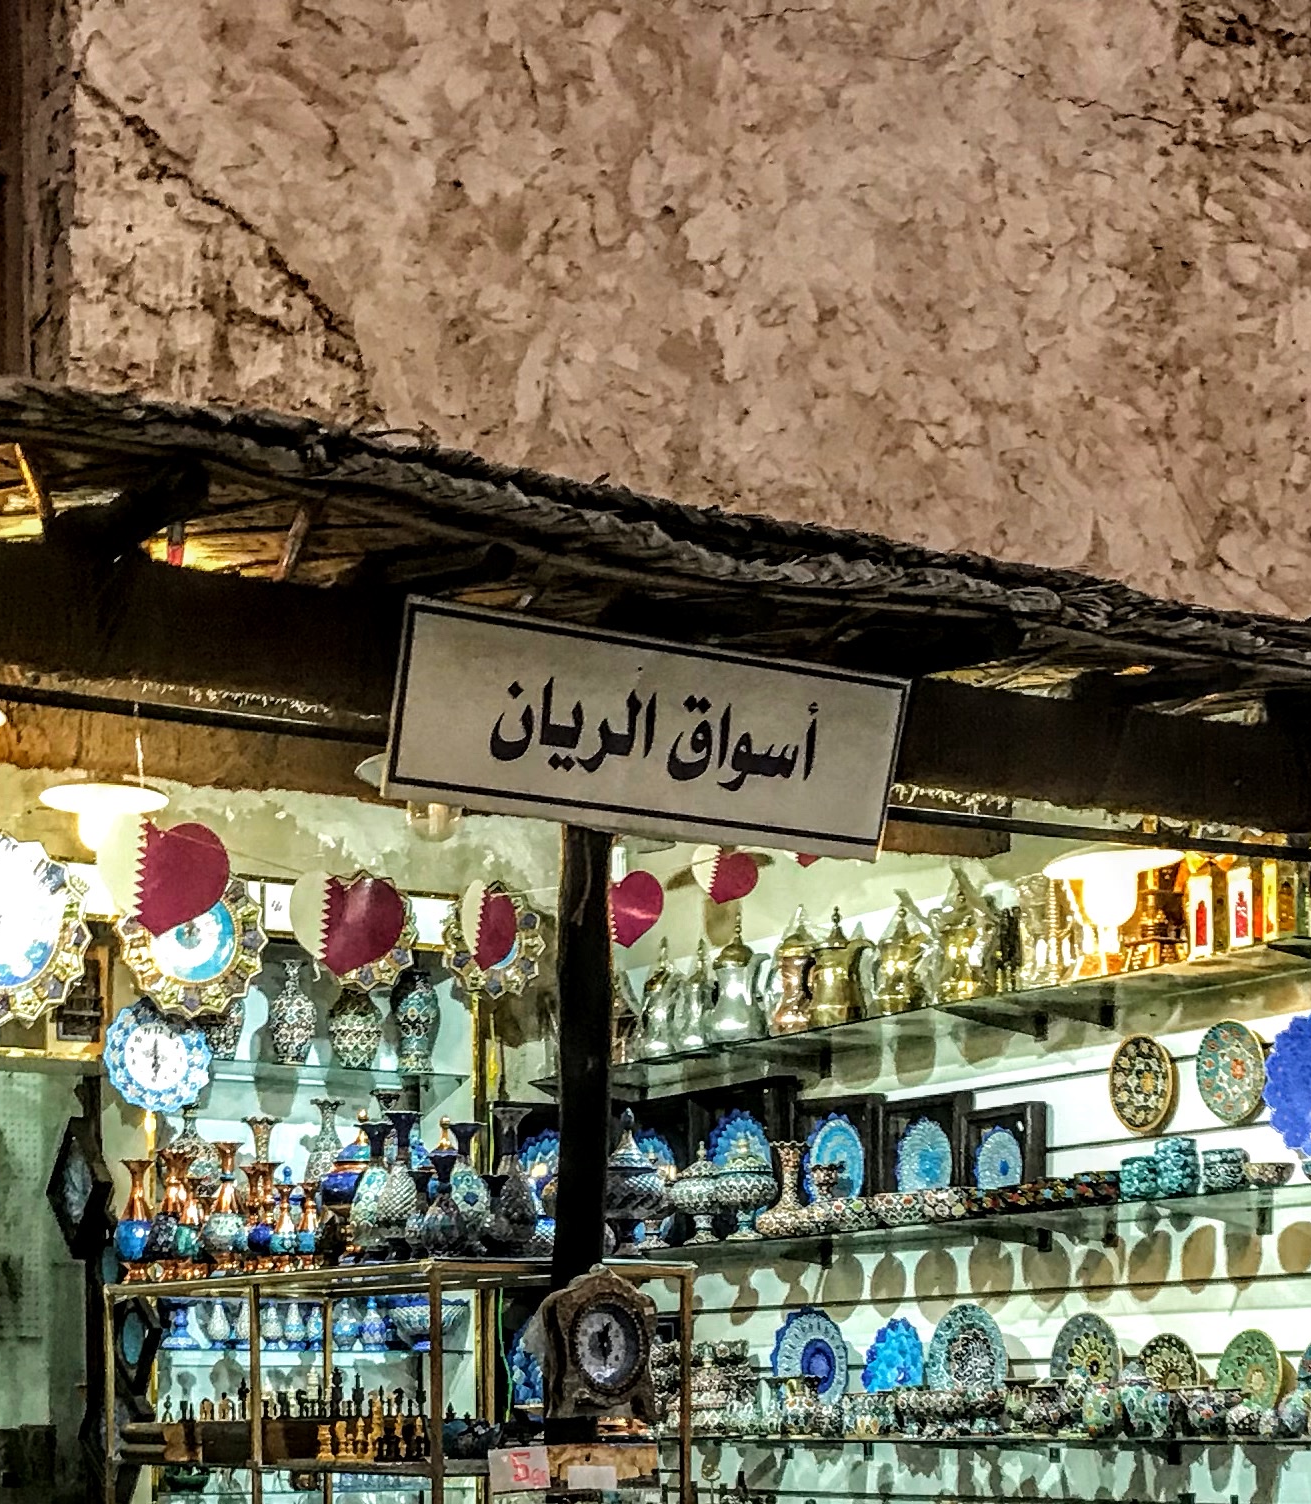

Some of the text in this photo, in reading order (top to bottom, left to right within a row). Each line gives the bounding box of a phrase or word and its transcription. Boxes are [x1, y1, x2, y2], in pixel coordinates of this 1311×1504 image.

[488, 676, 818, 791] أسواق الريان
[509, 1452, 530, 1482] 5
